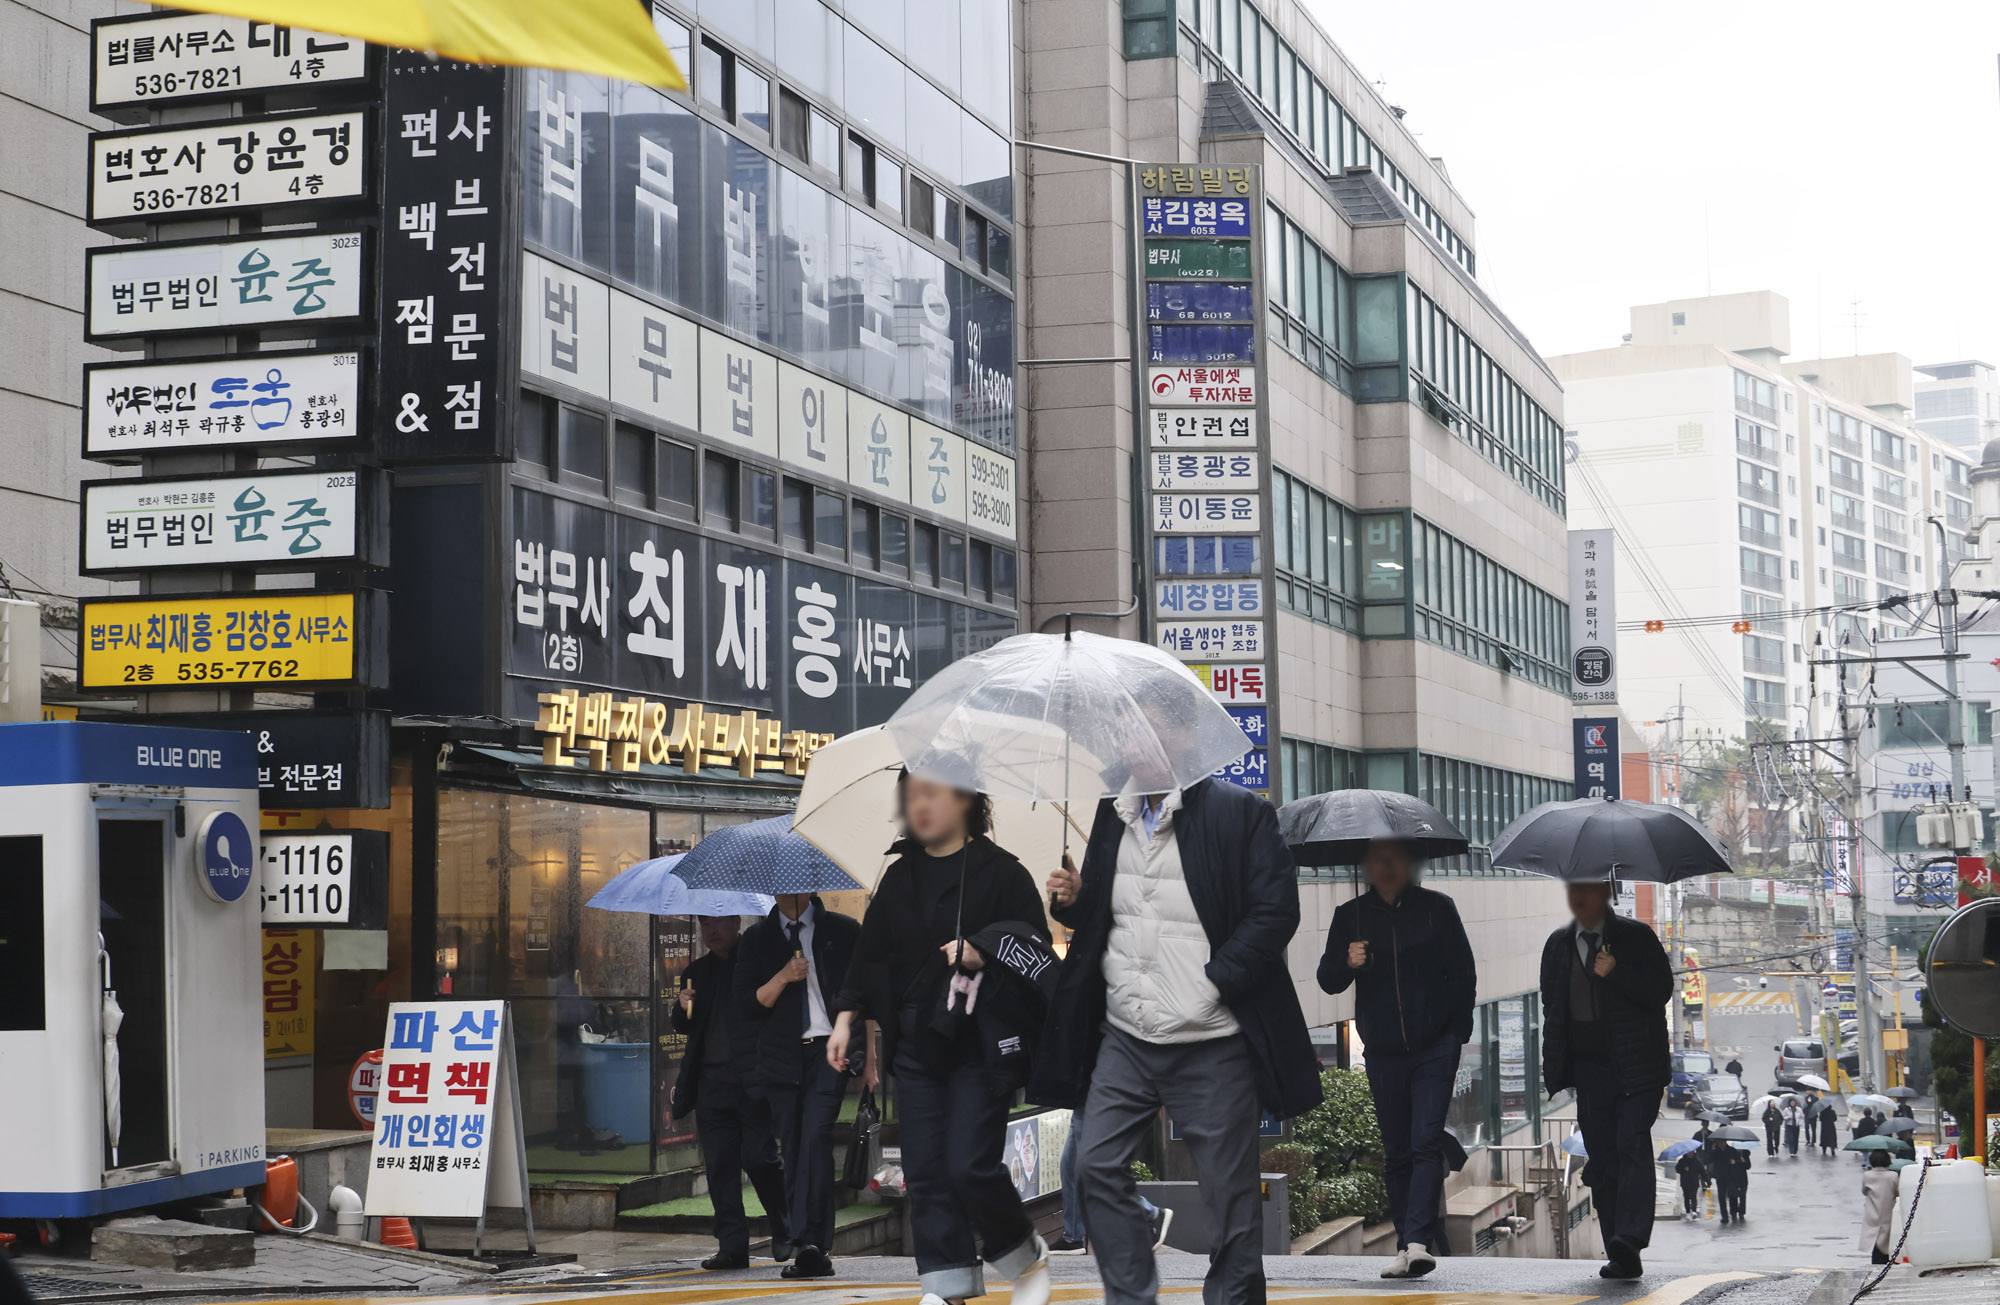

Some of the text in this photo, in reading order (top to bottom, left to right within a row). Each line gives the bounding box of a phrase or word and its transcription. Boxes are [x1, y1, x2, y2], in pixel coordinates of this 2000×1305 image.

[107, 20, 349, 66] 법률사무소 대
[135, 57, 326, 96] 536-7821 4층
[105, 121, 351, 183] 변호사 강윤경
[133, 173, 325, 212] 536-7821 4층
[1142, 166, 1250, 194] 하림빌딩
[1146, 198, 1246, 234] 법무사 김현옥
[1190, 226, 1216, 235] 605호
[331, 236, 361, 250] 302호
[1148, 248, 1181, 265] 법무사
[112, 247, 336, 315] 법무법인 윤중
[1202, 311, 1232, 319] 601호
[333, 354, 357, 368] 301호
[1177, 368, 1240, 384] 서울에셋
[106, 368, 292, 430] 법무법인 도움
[544, 276, 951, 504] 법무법인 윤중
[967, 358, 1013, 409] 711-3800
[1189, 387, 1253, 402] 투자자문
[308, 393, 338, 408] 변호사
[108, 414, 246, 438] 변호사 최석두 곽규홍
[299, 408, 346, 430] 홍광의
[1175, 417, 1249, 437] 안권섭
[326, 476, 356, 488] 202호
[970, 453, 1010, 493] 599-5301
[1158, 454, 1251, 488] 법무사 홍광호
[138, 496, 160, 506] 변호사
[971, 489, 1011, 528] 596-3900
[1159, 496, 1253, 530] 법무사 이동윤
[106, 485, 332, 555] 법무법인 윤중
[1367, 518, 1401, 591] 바둑
[1160, 583, 1259, 612] 세창합동
[90, 621, 143, 651] 법무사
[295, 614, 348, 644] 사무소
[515, 538, 610, 639] 법무사
[626, 539, 841, 698] 최재홍
[854, 618, 912, 689] 사무소
[1231, 624, 1258, 637] 협동
[1586, 607, 1598, 640] 담아서
[542, 631, 584, 674] (2층)
[1163, 627, 1226, 651] 서울생약
[1231, 639, 1258, 652] 조합
[123, 659, 299, 682] 2층 535-7762
[1214, 667, 1264, 700] 바둑
[1572, 691, 1616, 701] 595-1388
[279, 763, 343, 792] 전문점
[1242, 776, 1263, 785] 301호
[262, 930, 302, 1013] 상담
[390, 1010, 499, 1052] 파산
[386, 1062, 490, 1105] 면책
[379, 1114, 485, 1149] 개인회생
[377, 1155, 481, 1172] 법무사 최재홍 사무소
